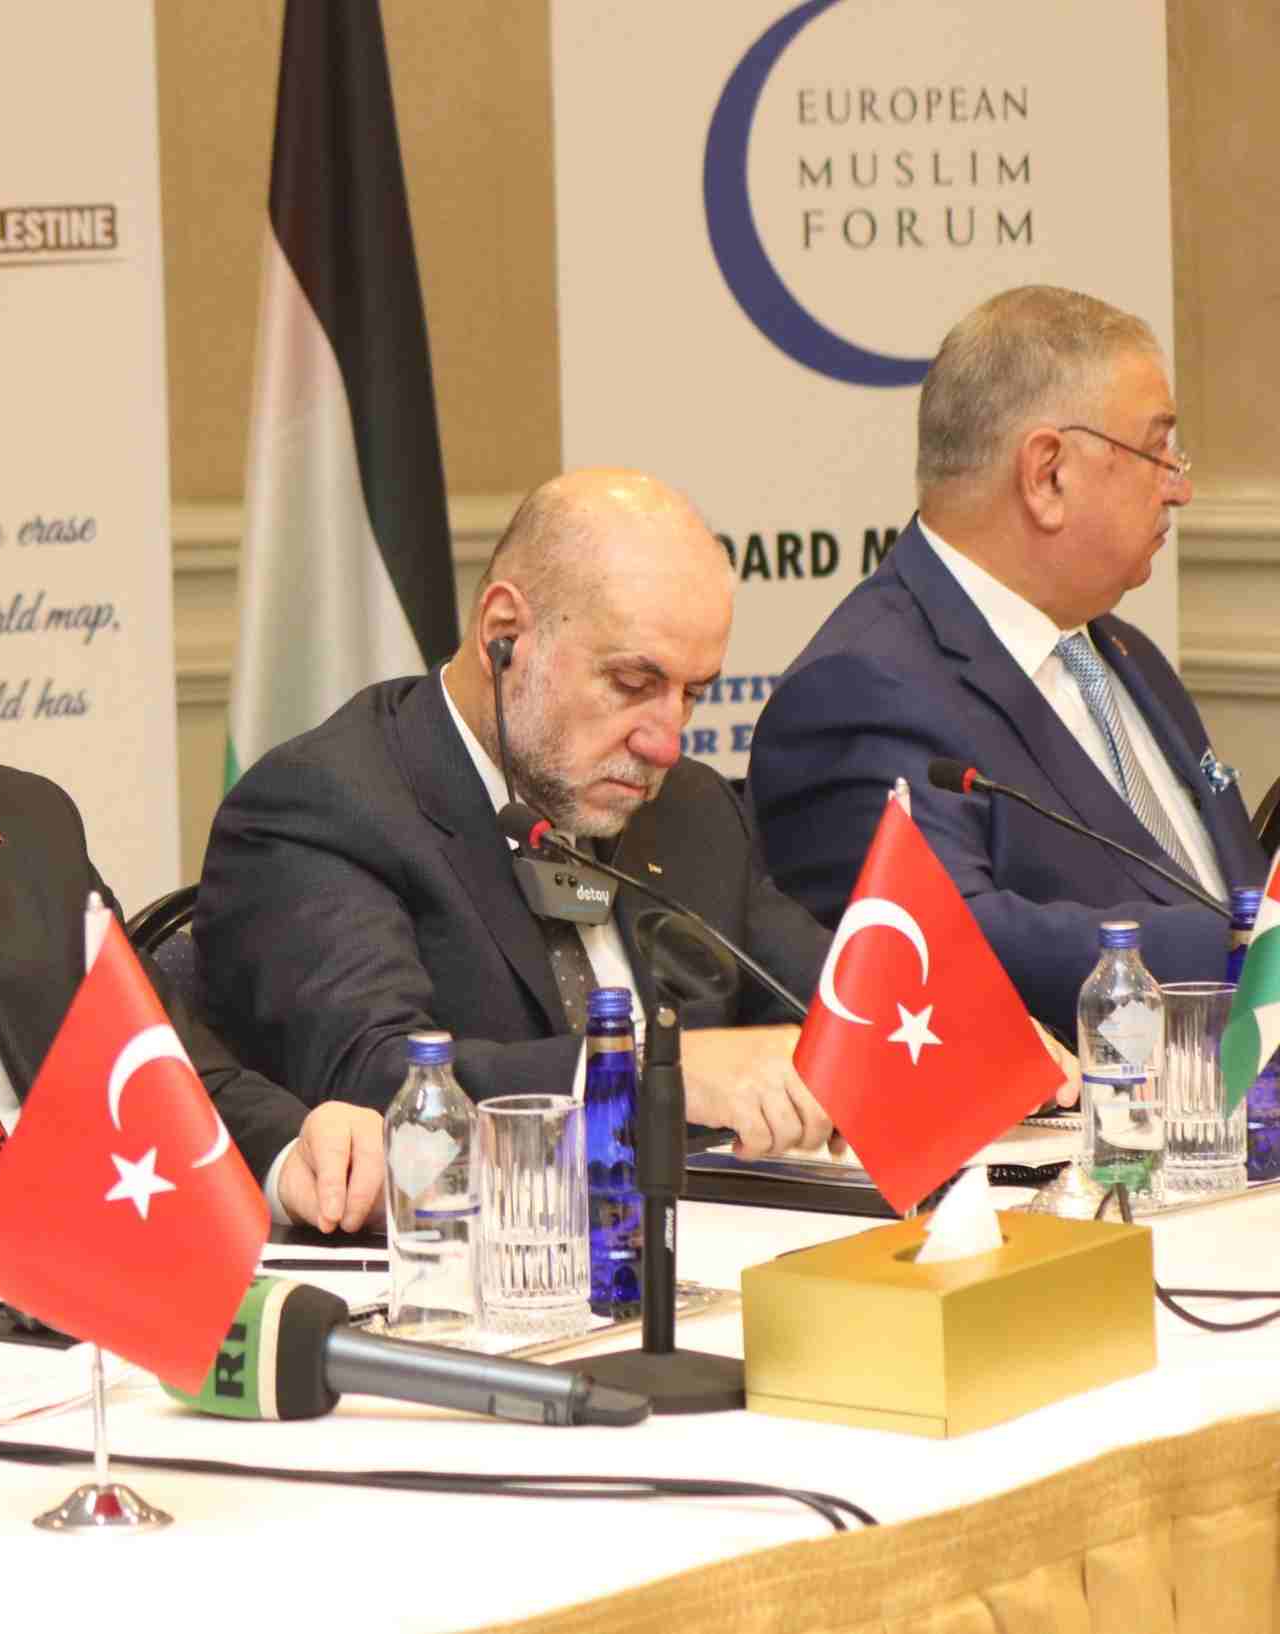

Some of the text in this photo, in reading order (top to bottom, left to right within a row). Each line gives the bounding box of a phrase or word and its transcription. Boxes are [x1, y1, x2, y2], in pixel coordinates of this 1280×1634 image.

[797, 85, 1030, 126] EUROPEAN
[798, 149, 1033, 190] MUSLIM
[801, 205, 1035, 252] FORUM
[18, 515, 96, 545] erase
[716, 526, 840, 580] ARD
[33, 677, 90, 720] has
